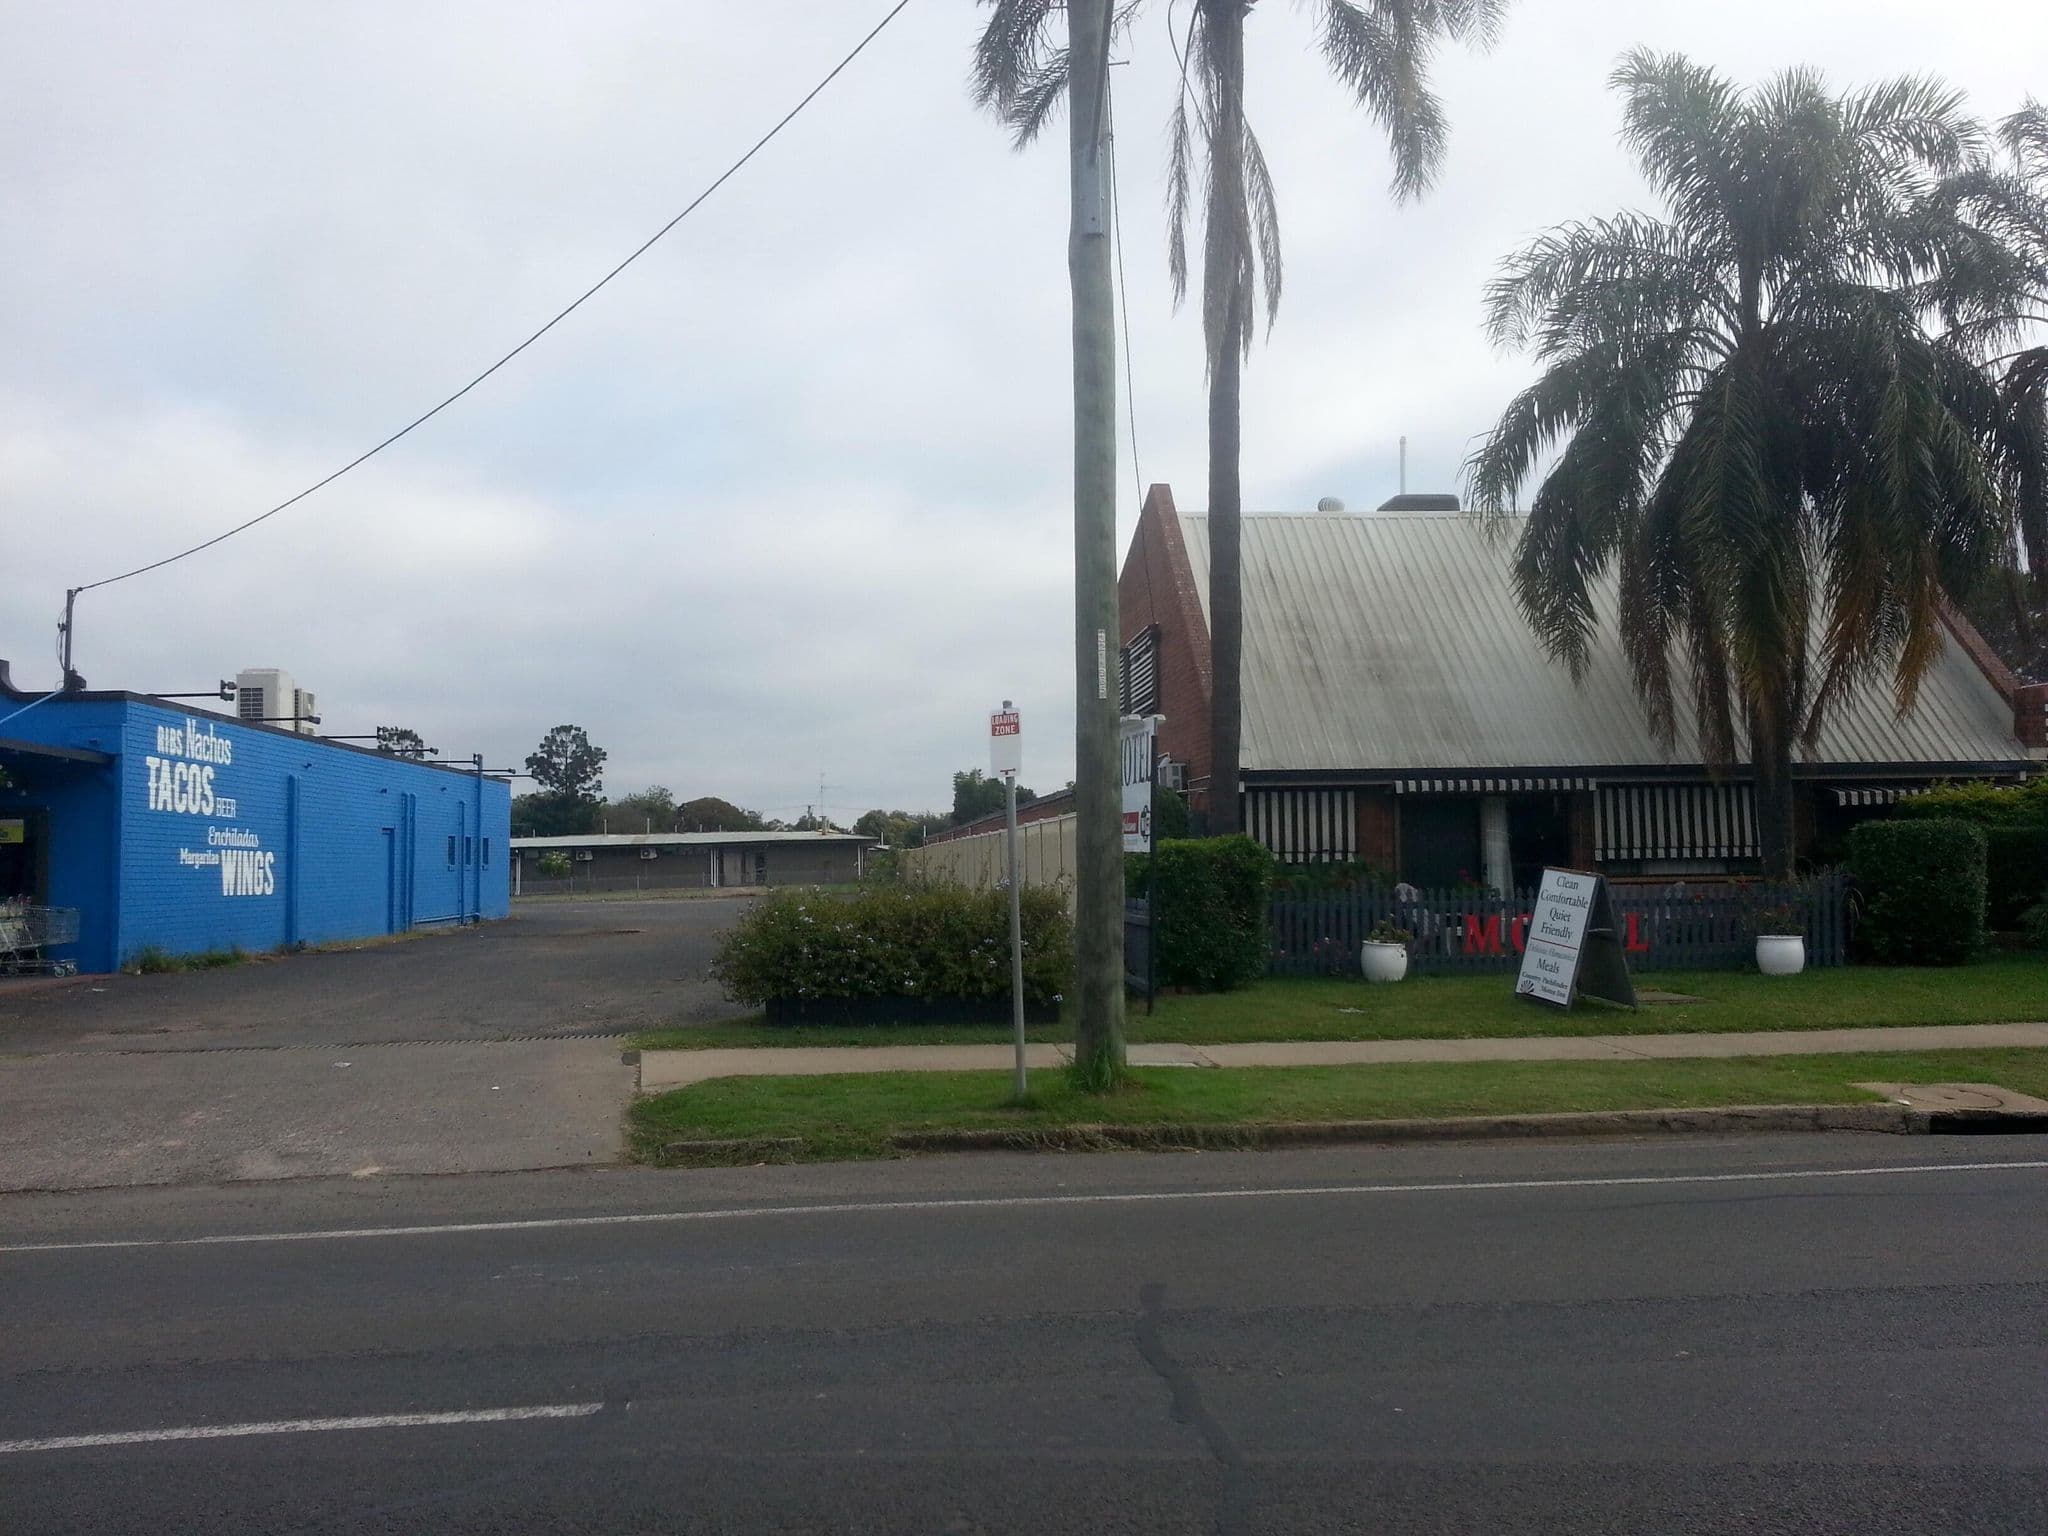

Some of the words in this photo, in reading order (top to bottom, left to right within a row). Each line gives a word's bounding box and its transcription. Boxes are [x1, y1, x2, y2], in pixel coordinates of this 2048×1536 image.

[992, 714, 1018, 725] LOADING
[995, 725, 1016, 735] ZONE
[157, 726, 183, 756] RIBS
[186, 718, 232, 766] Nachos
[146, 756, 215, 816] TACOS
[216, 798, 236, 818] BEER
[208, 826, 259, 847] Enchiladas
[179, 848, 219, 869] Margaritas
[221, 850, 275, 896] WINGS
[1556, 876, 1579, 890] Clean
[1540, 890, 1588, 909] Comfortable
[1549, 908, 1571, 922] Quiet
[1541, 922, 1573, 942] Friendly
[1536, 958, 1560, 973] Meals
